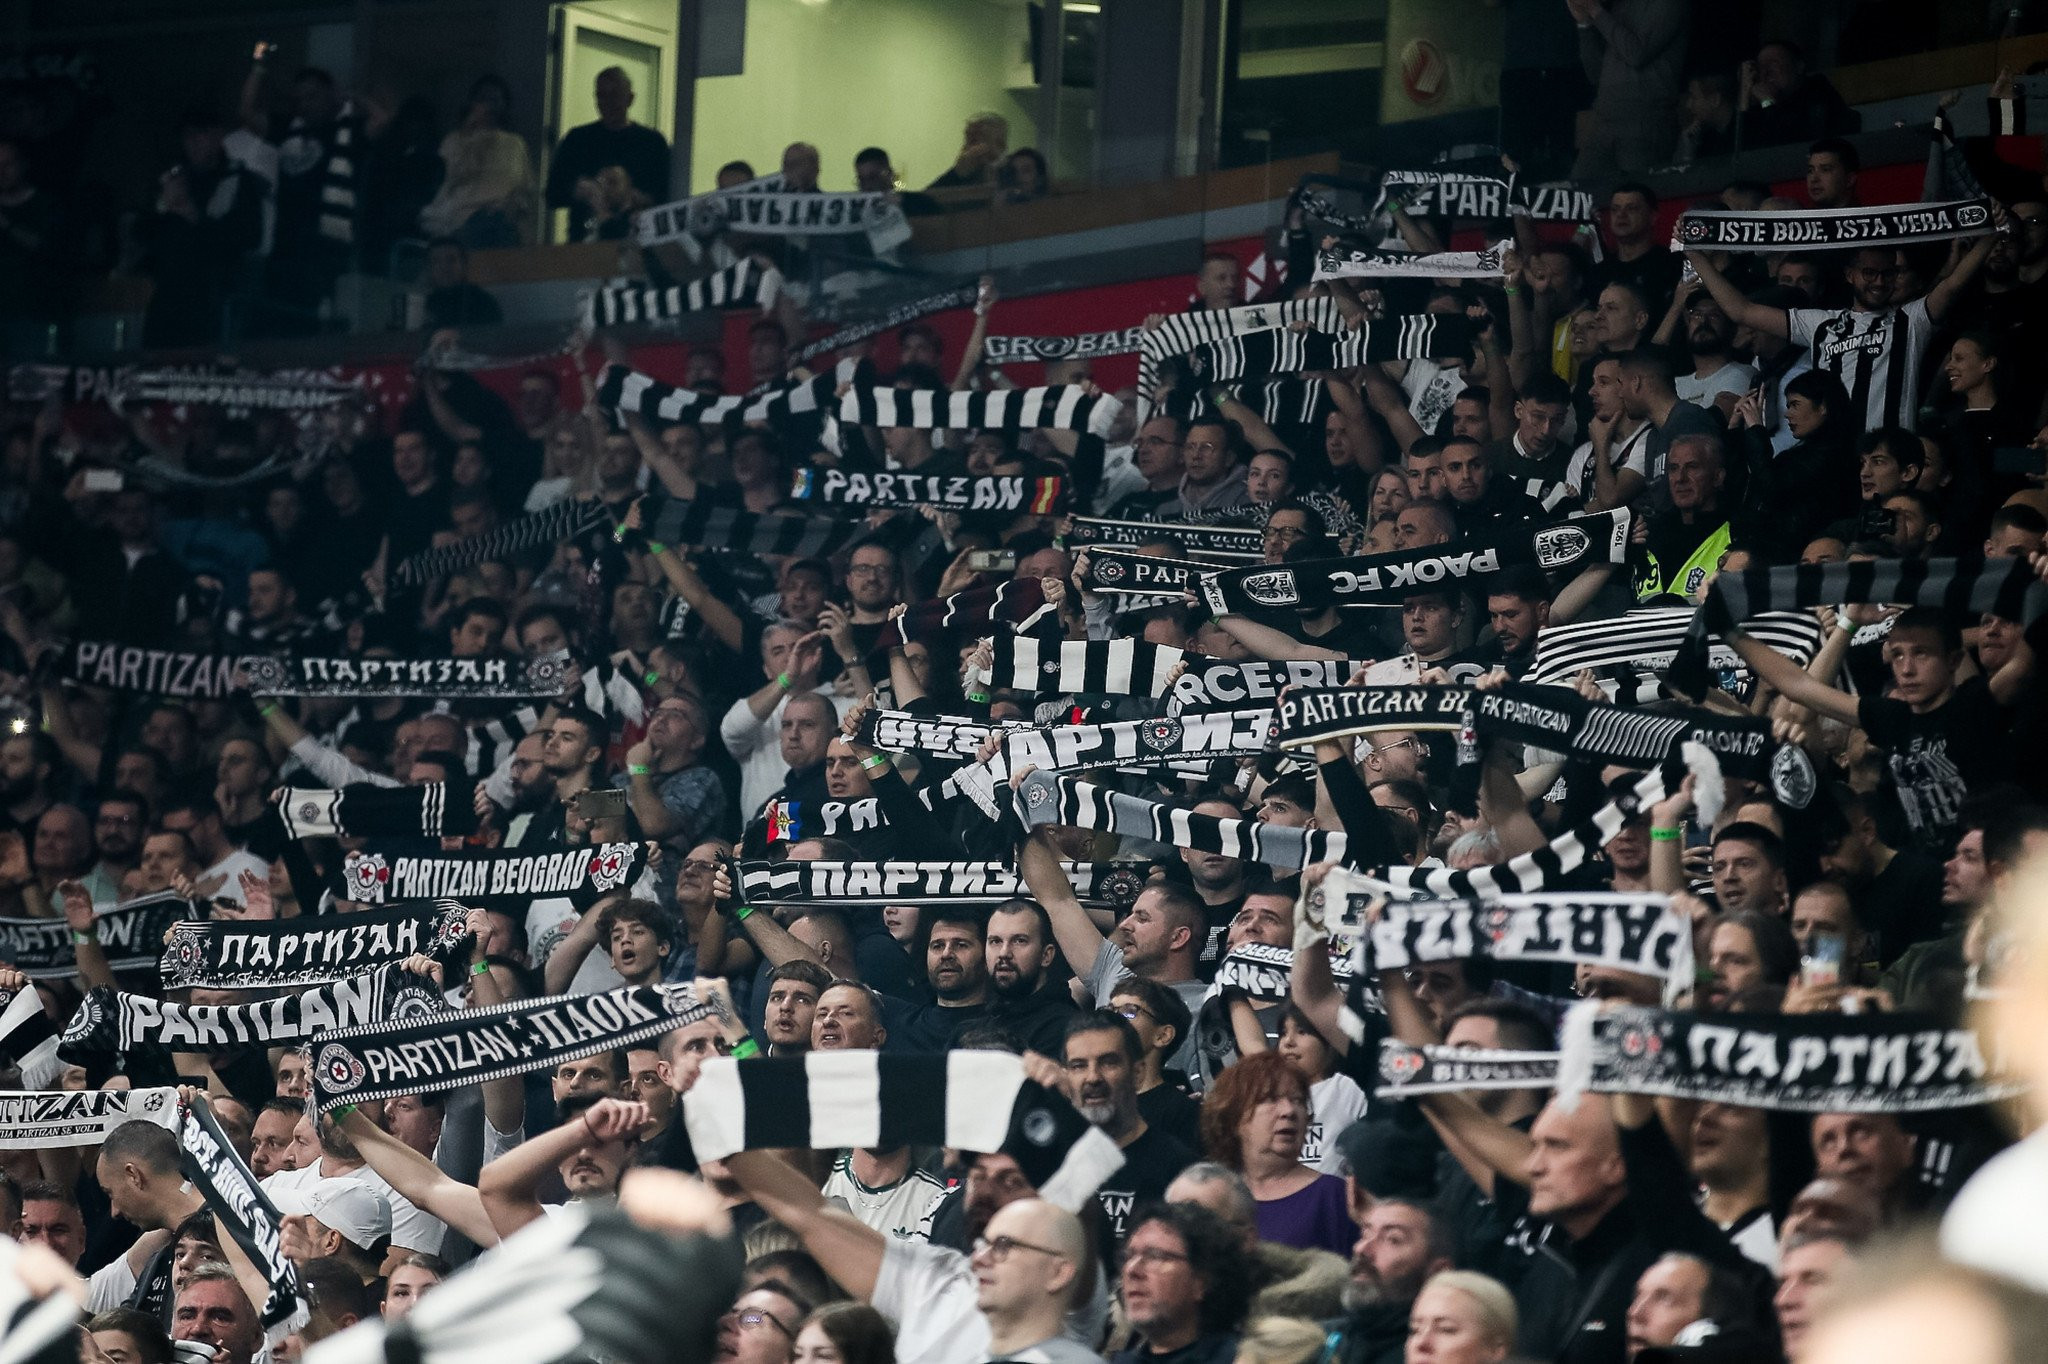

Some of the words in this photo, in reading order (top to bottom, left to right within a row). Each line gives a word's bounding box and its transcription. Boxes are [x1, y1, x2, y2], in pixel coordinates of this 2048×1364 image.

[1438, 182, 1593, 219] PARZAN
[1718, 222, 1766, 242] ISTE
[1773, 220, 1828, 243] BOJE,
[1836, 216, 1888, 239] ISTA
[1891, 210, 1953, 235] VERA
[823, 469, 1025, 511] PARTIZAN
[1328, 567, 1384, 594] FC
[1384, 548, 1500, 587] PAOK
[76, 642, 240, 699] PARTIZAN
[302, 657, 507, 684] ПАРТИЗАН
[1281, 690, 1429, 729] PARTIZAN
[1481, 694, 1504, 718] FK
[1503, 699, 1572, 733] PARTIZAN
[820, 797, 889, 836] PA
[391, 857, 490, 898] PARTIZAN
[489, 848, 593, 895] BEOGRAD
[810, 861, 1093, 896] ПАРТИЗН
[218, 916, 421, 970] ПАРТИЗАН
[364, 1026, 519, 1083] PARTIZAN
[1689, 1022, 1990, 1088] ПАРТИЗА
[16, 1127, 60, 1139] PARTIZAN
[61, 1126, 73, 1136] SE
[75, 1124, 97, 1134] VOLI
